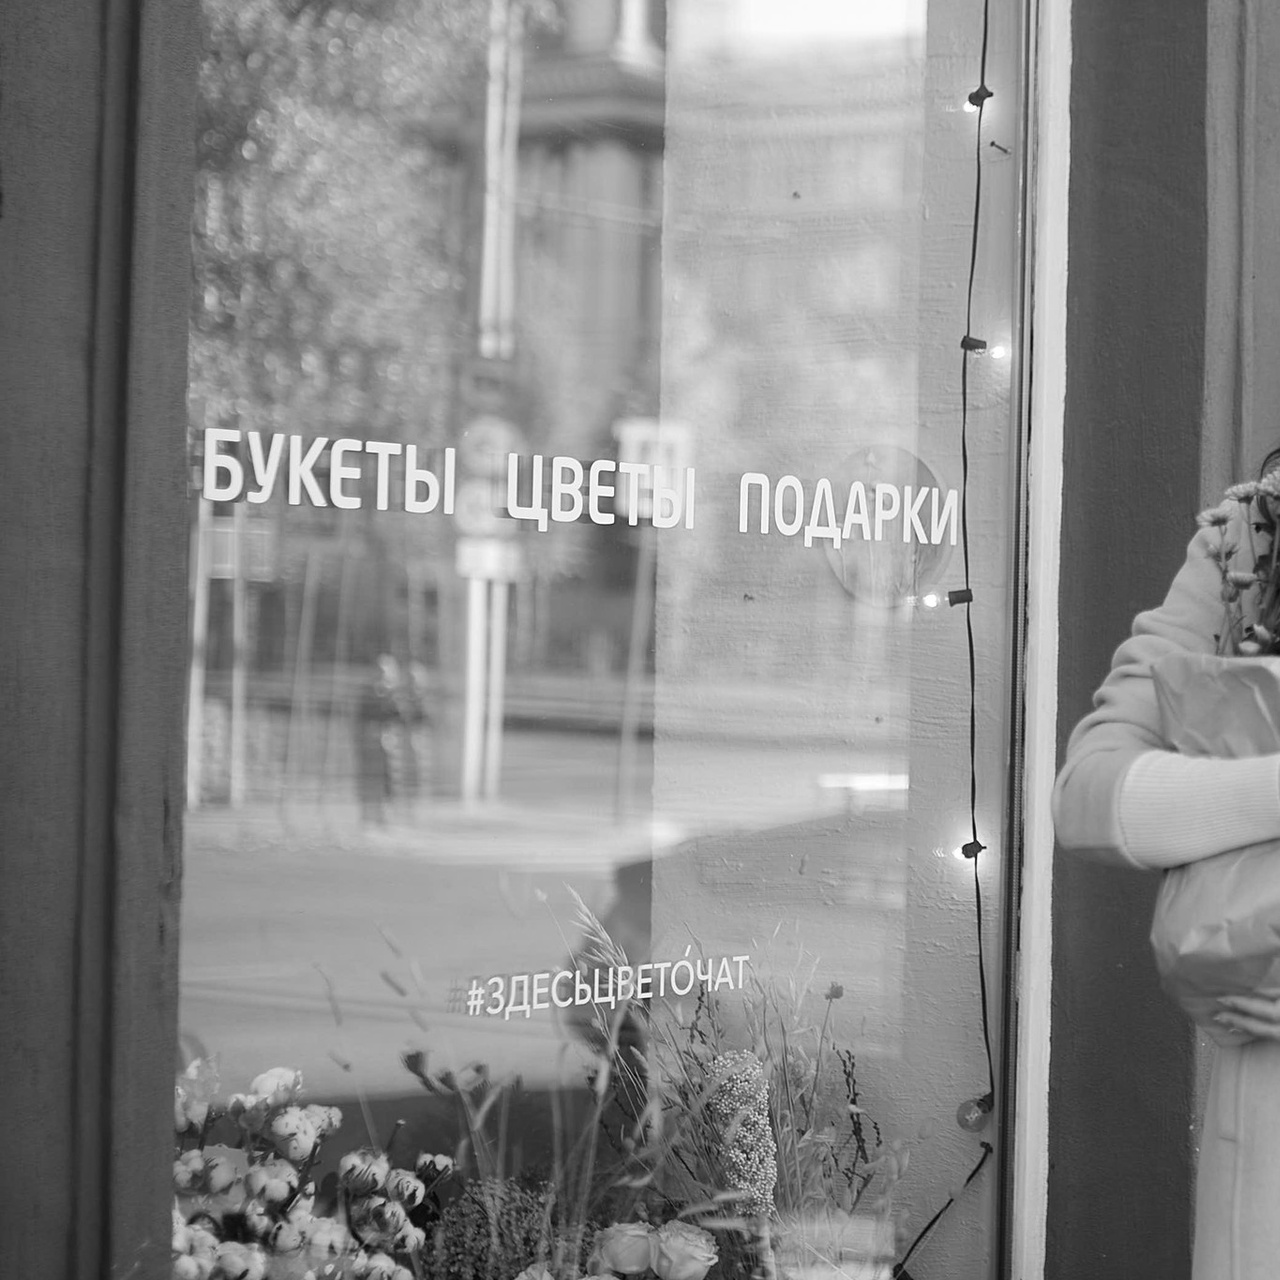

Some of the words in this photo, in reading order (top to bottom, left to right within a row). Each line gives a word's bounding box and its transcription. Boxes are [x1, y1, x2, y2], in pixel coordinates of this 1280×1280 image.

[203, 427, 456, 516] БУКЕТЫ
[506, 451, 696, 533] ЦВЕТЫ
[738, 471, 959, 550] ПОДАРКИ
